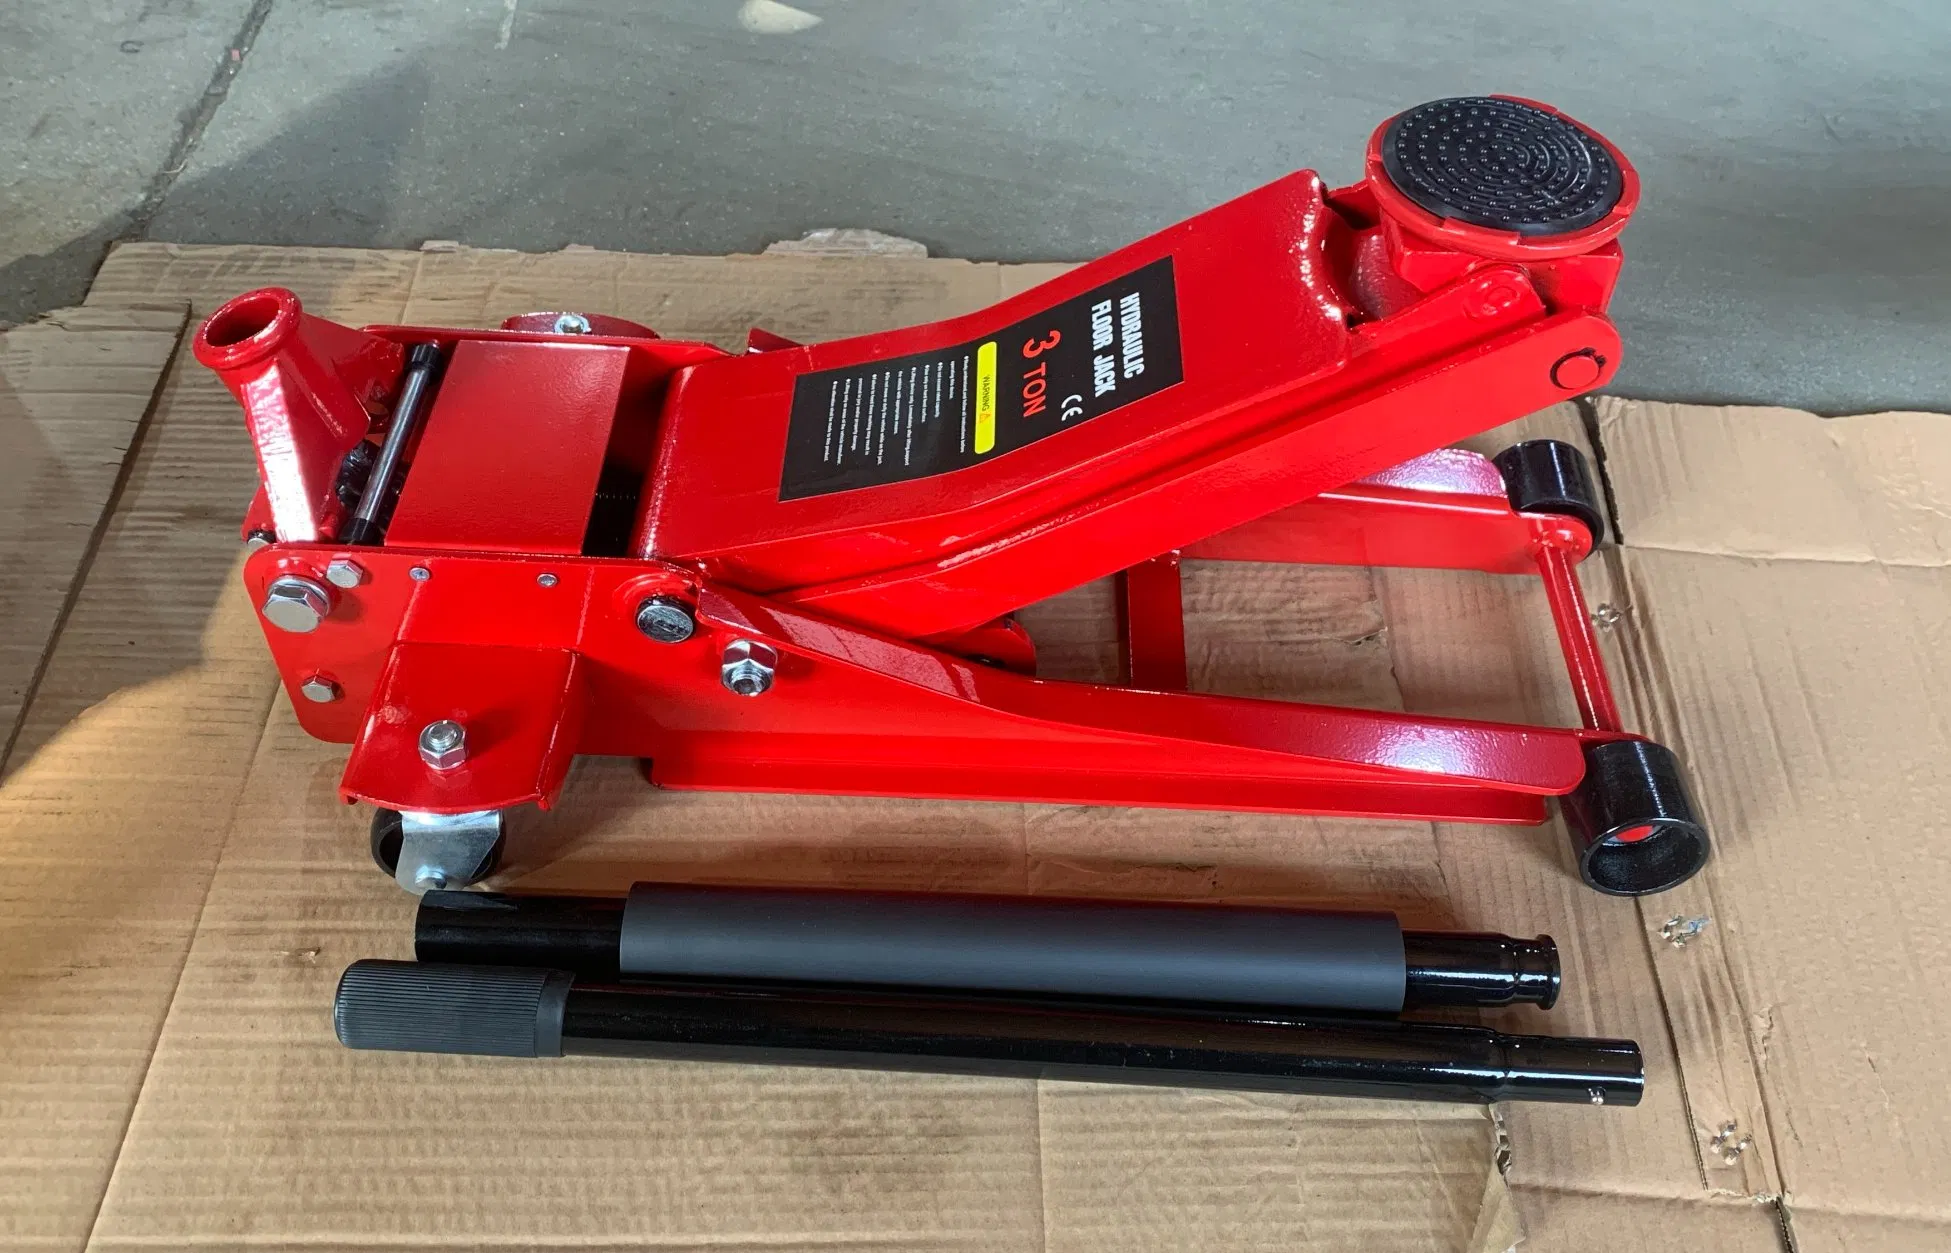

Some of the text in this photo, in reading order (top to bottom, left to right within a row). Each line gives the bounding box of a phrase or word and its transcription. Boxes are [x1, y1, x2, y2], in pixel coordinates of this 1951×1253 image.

[1022, 330, 1061, 418] 3 TON
[1092, 299, 1116, 398] FLOOR JACK
[1120, 292, 1144, 379] HYDRAULIC
[981, 374, 991, 412] WARNING
[1061, 394, 1083, 421] CE
